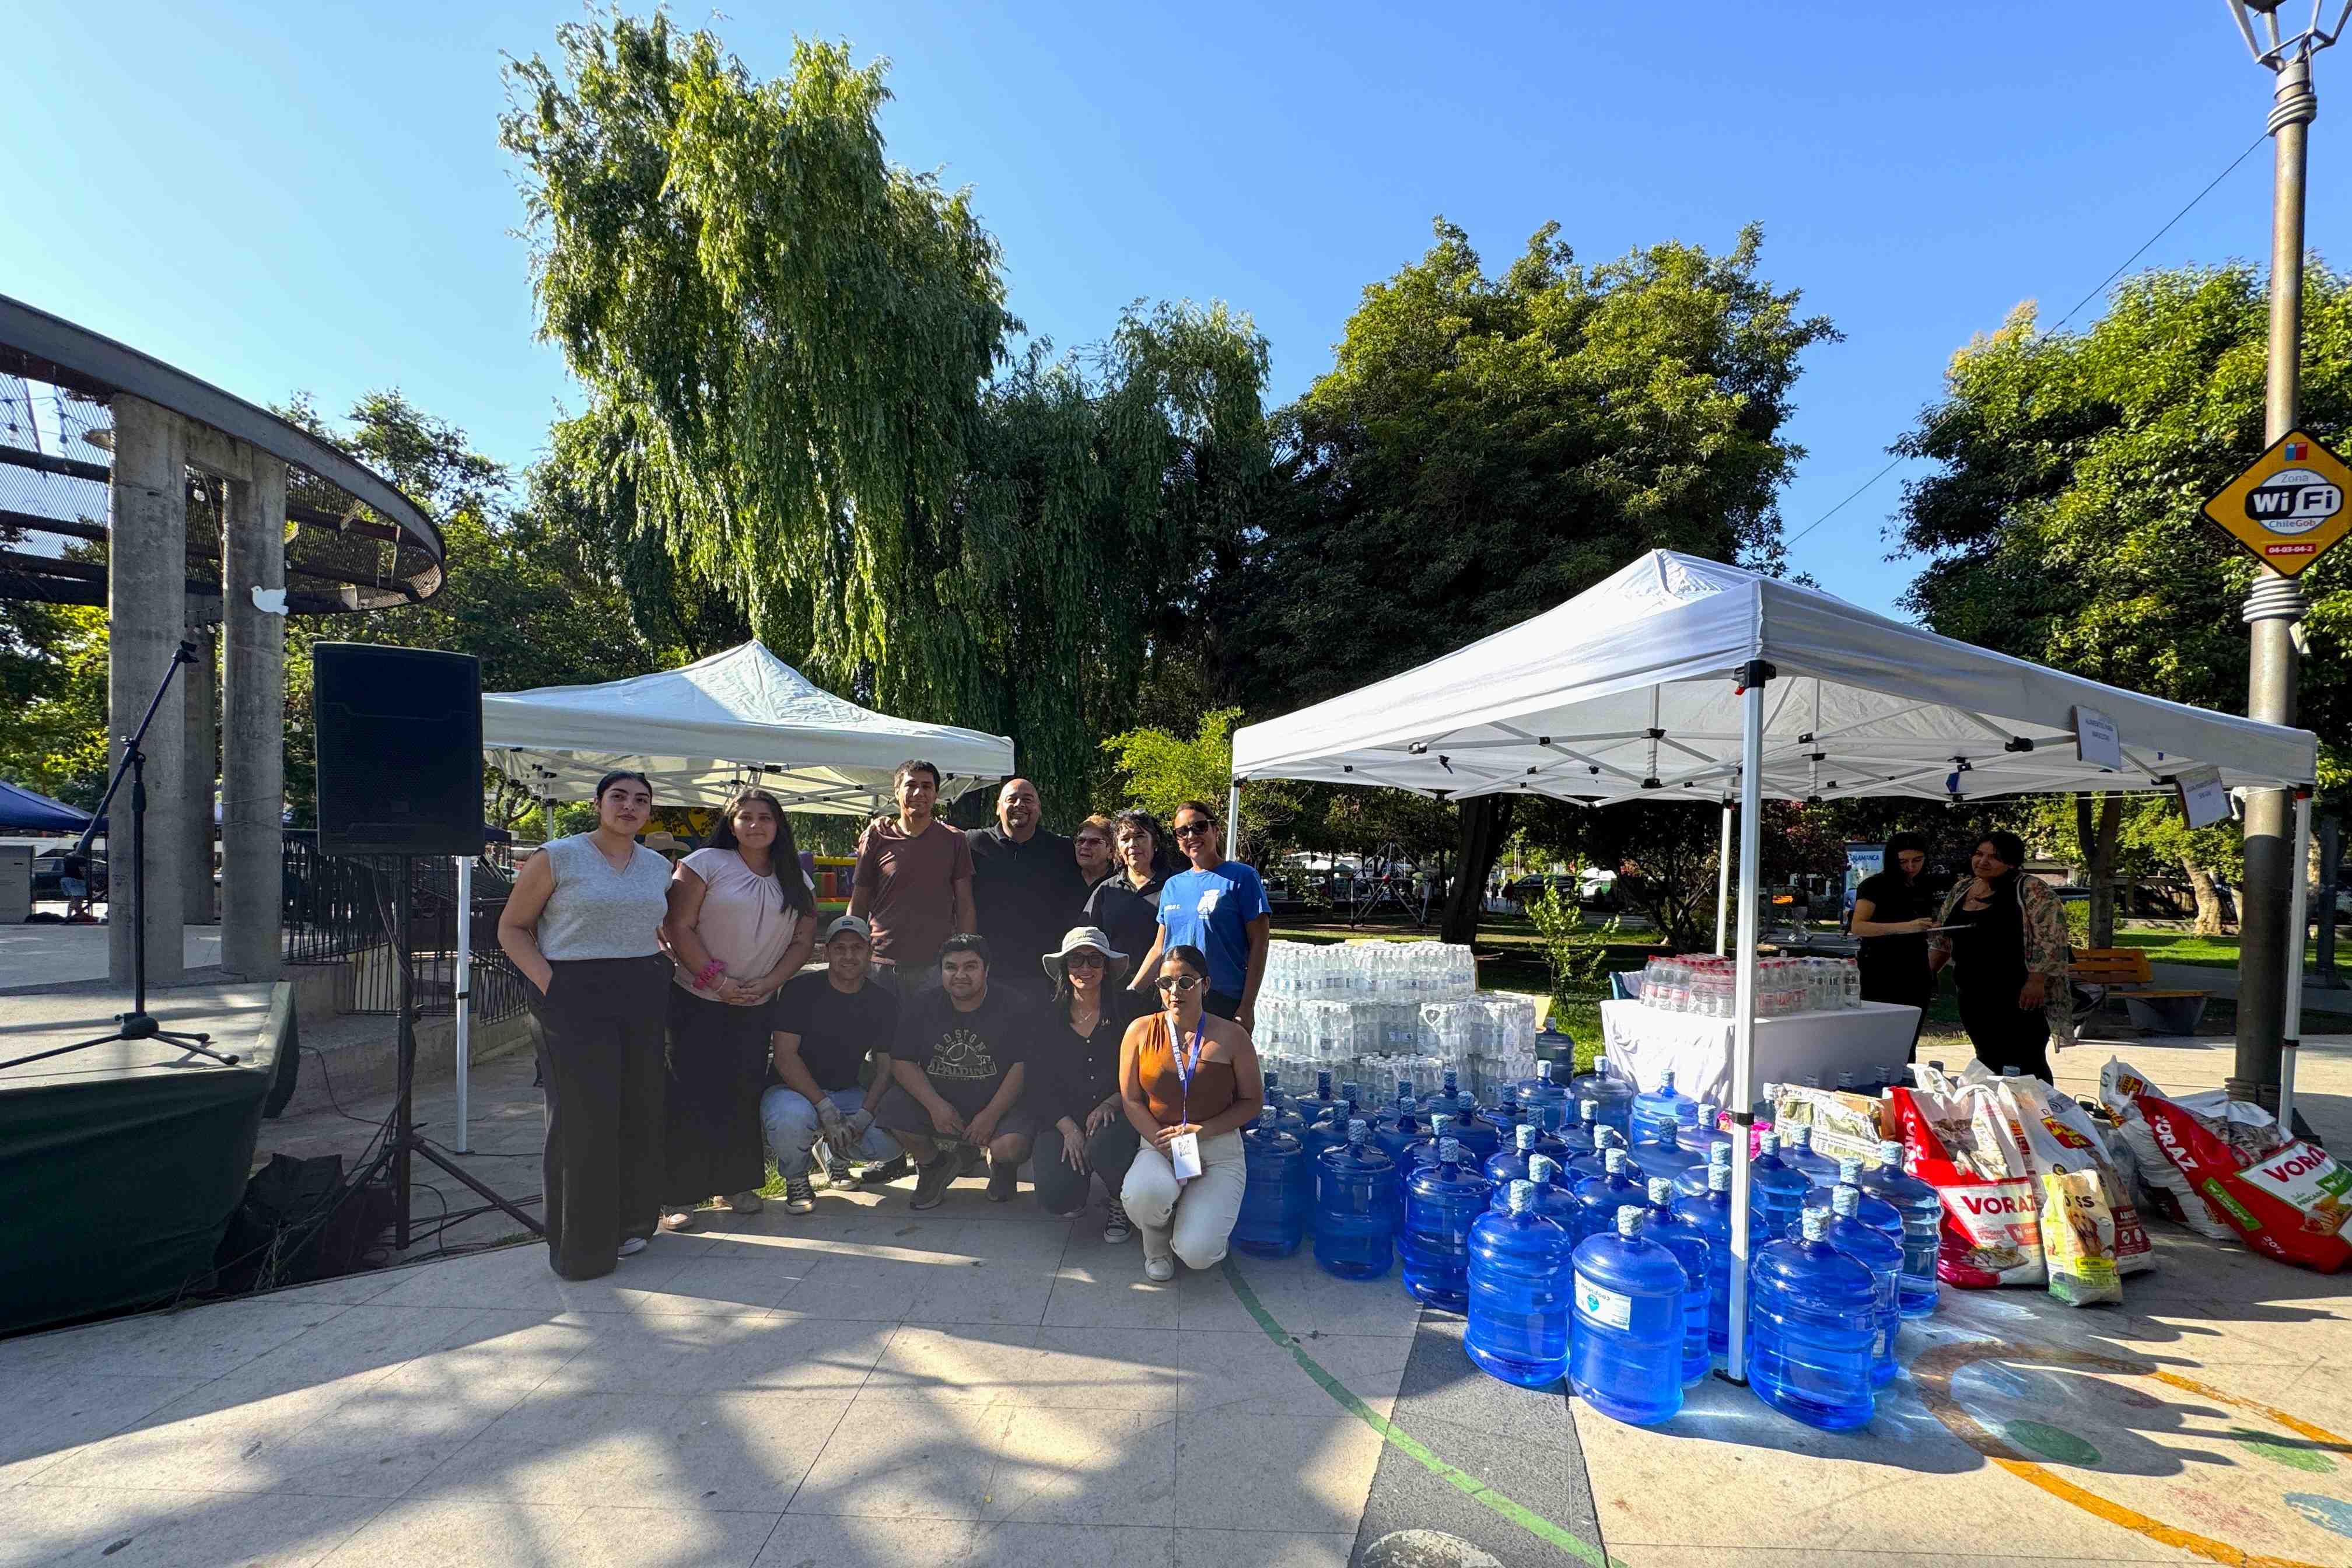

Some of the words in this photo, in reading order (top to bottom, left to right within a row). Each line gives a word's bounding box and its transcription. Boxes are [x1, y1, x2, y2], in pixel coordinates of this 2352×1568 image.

[2281, 474, 2309, 483] Zona
[2269, 519, 2316, 528] ChileGob
[935, 1029, 986, 1052] BOSTON
